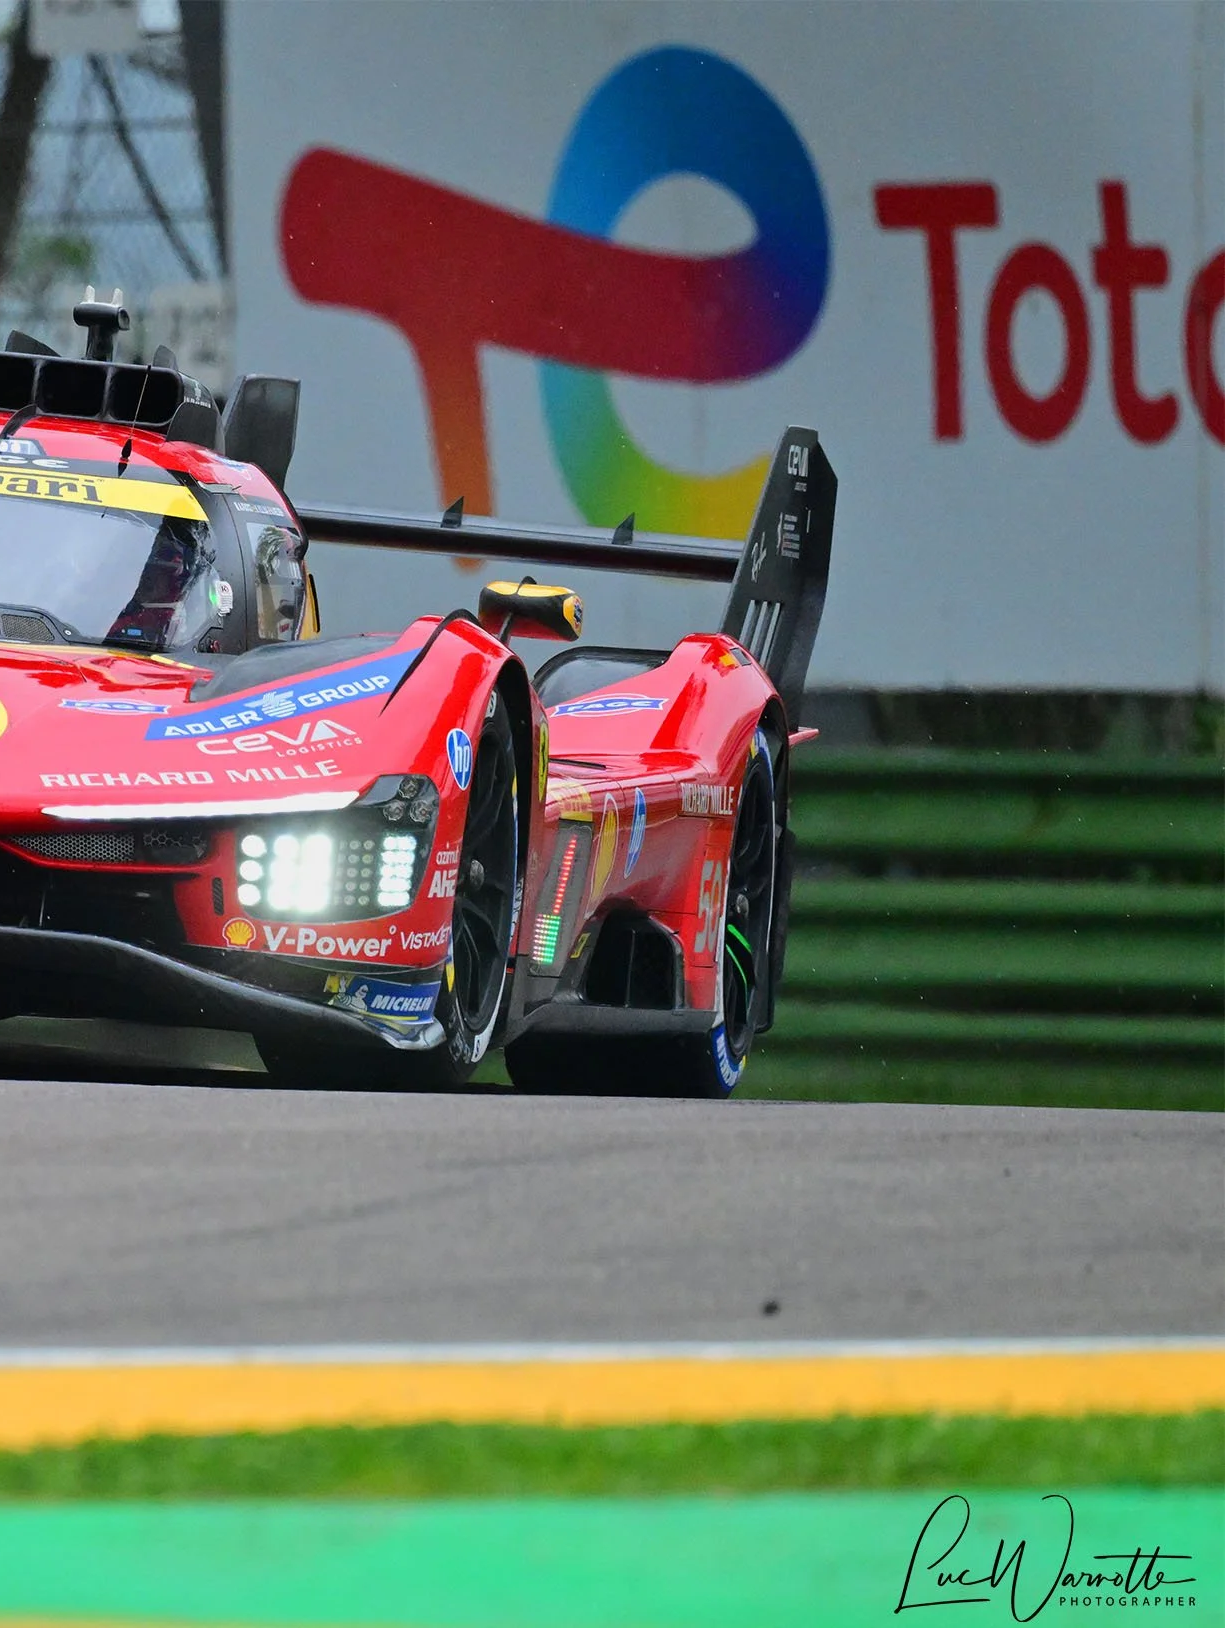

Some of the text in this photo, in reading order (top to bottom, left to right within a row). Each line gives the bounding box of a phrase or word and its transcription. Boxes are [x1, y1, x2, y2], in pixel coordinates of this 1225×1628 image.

[164, 675, 391, 737] ADLER GROUP
[276, 737, 363, 758] LOGISTICS
[452, 731, 470, 789] hp
[39, 759, 343, 788] RICHARD MILLE
[694, 860, 722, 953] 50
[263, 925, 392, 957] V-Power
[371, 994, 433, 1012] MICHELIN
